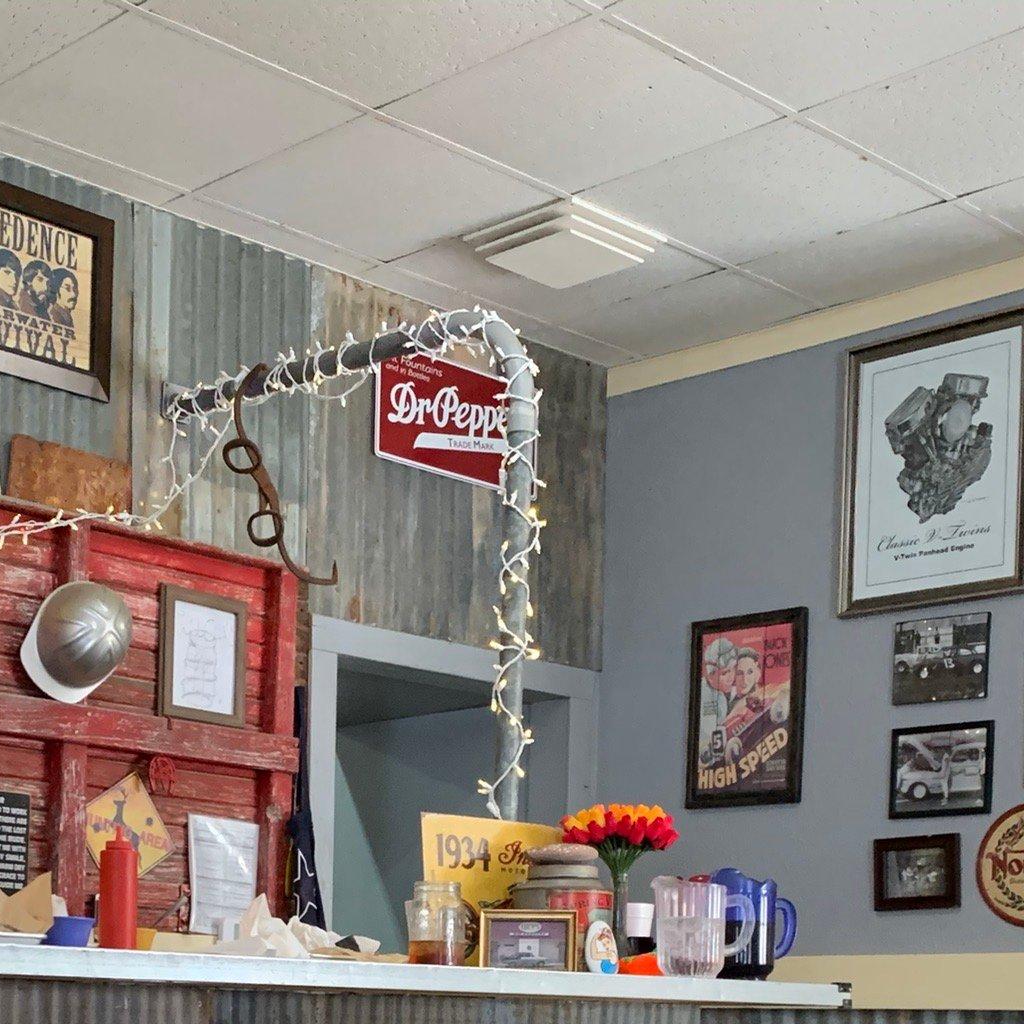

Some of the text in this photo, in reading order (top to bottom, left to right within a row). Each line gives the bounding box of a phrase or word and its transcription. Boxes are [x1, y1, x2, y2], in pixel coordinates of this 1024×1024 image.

[432, 385, 508, 438] Peppe
[877, 534, 920, 552] Classic
[951, 543, 975, 552] Engine
[698, 728, 788, 789] HIGH SPEED
[435, 834, 530, 871] 1934 In
